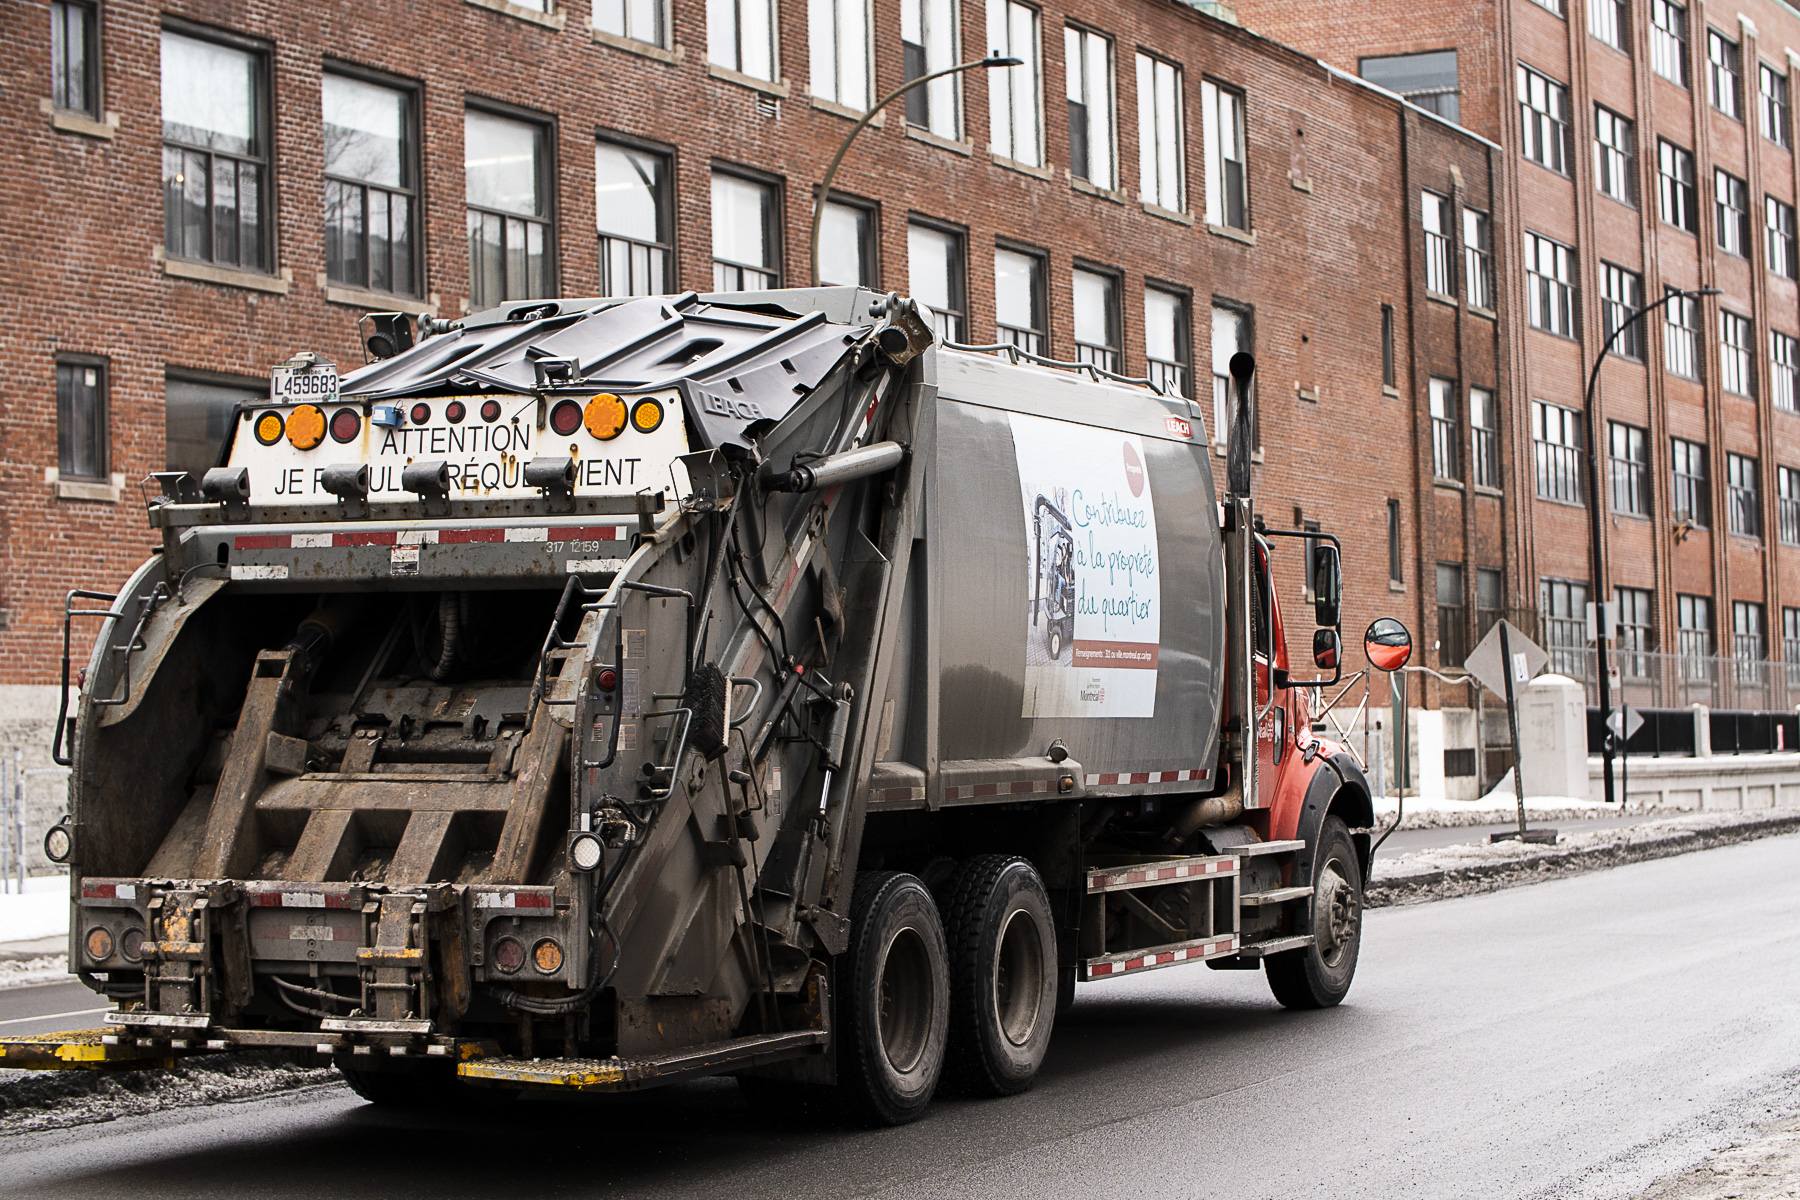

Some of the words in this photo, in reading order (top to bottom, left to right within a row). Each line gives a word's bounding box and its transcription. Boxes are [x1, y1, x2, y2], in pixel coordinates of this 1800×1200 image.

[275, 375, 336, 395] L459683
[698, 390, 766, 420] LEACH
[381, 423, 531, 455] ATTENTION
[1166, 419, 1191, 435] LEACH
[274, 468, 304, 495] JE
[1072, 489, 1148, 529] Contribuez
[546, 541, 565, 553] 317
[569, 540, 600, 553] 12159
[1076, 540, 1087, 567] à
[1088, 530, 1106, 569] la
[1107, 543, 1155, 588] propreté
[1077, 577, 1099, 615] du
[1101, 589, 1151, 633] quartier
[1080, 690, 1100, 702] Montréal
